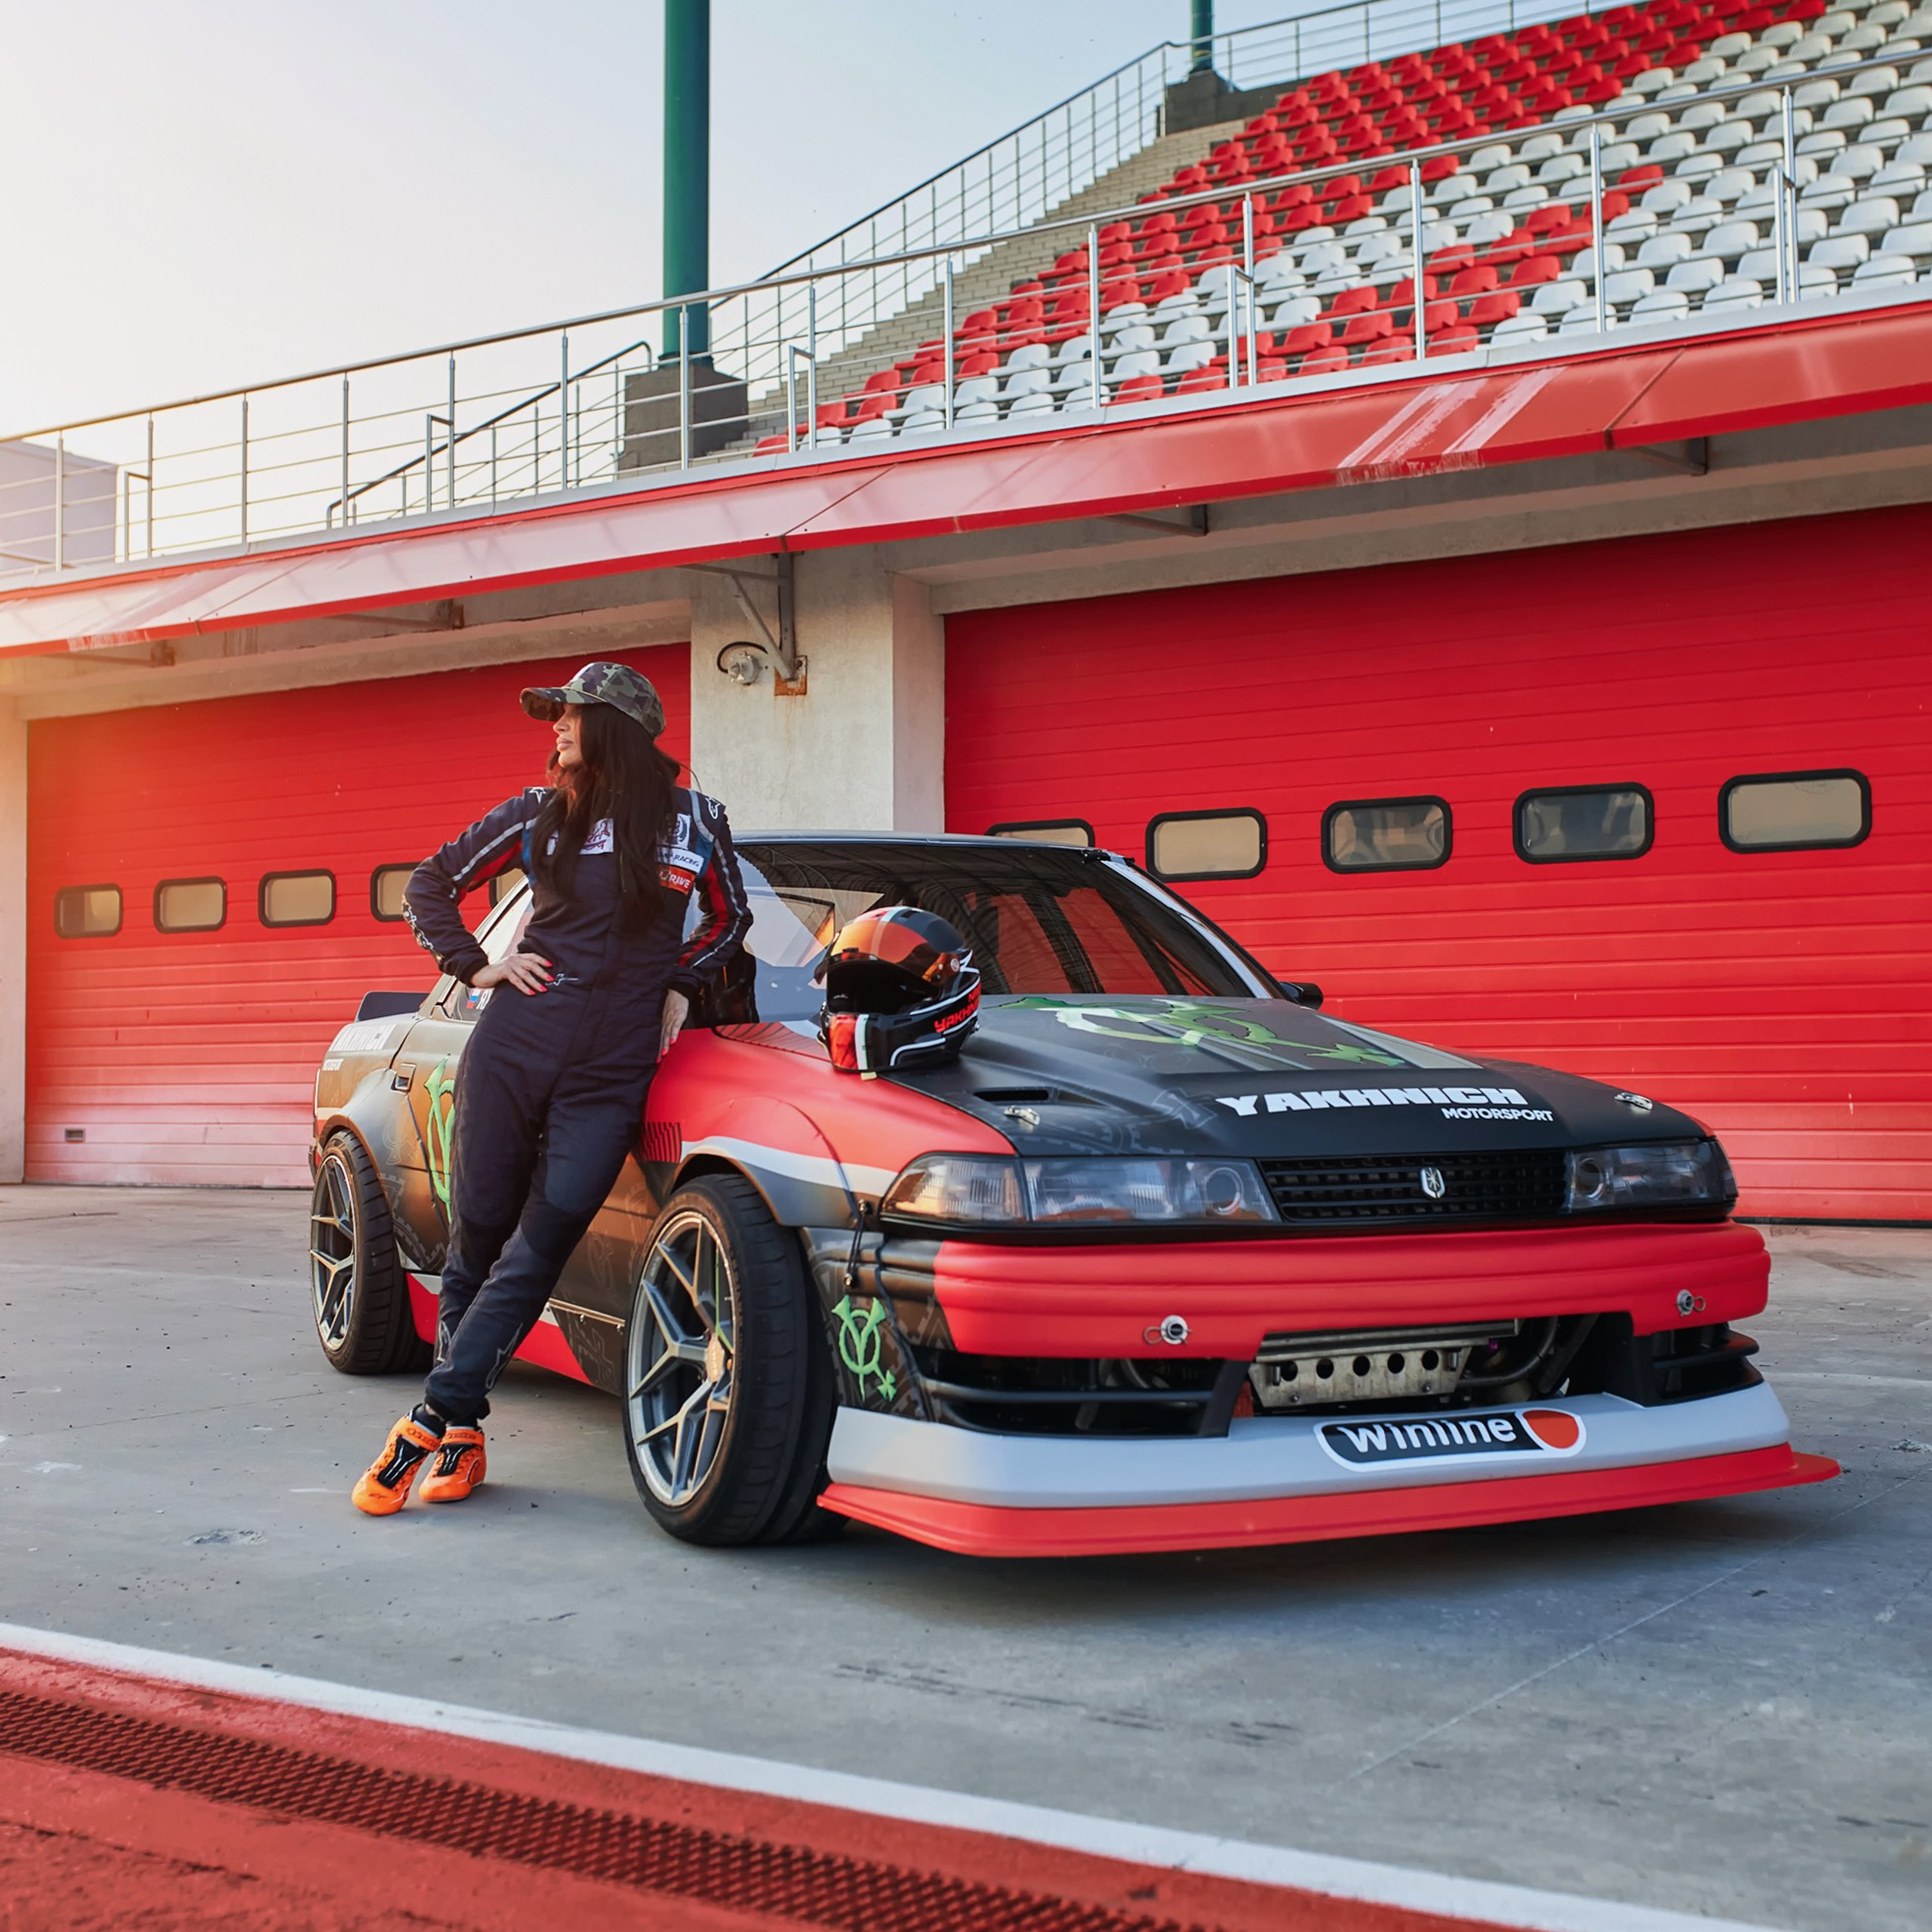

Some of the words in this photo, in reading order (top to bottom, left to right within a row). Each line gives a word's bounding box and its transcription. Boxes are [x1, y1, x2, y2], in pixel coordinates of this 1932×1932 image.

[674, 854, 700, 867] RACING
[1216, 1087, 1528, 1116] YAKHNICH
[1441, 1107, 1554, 1123] MOTORSPORT
